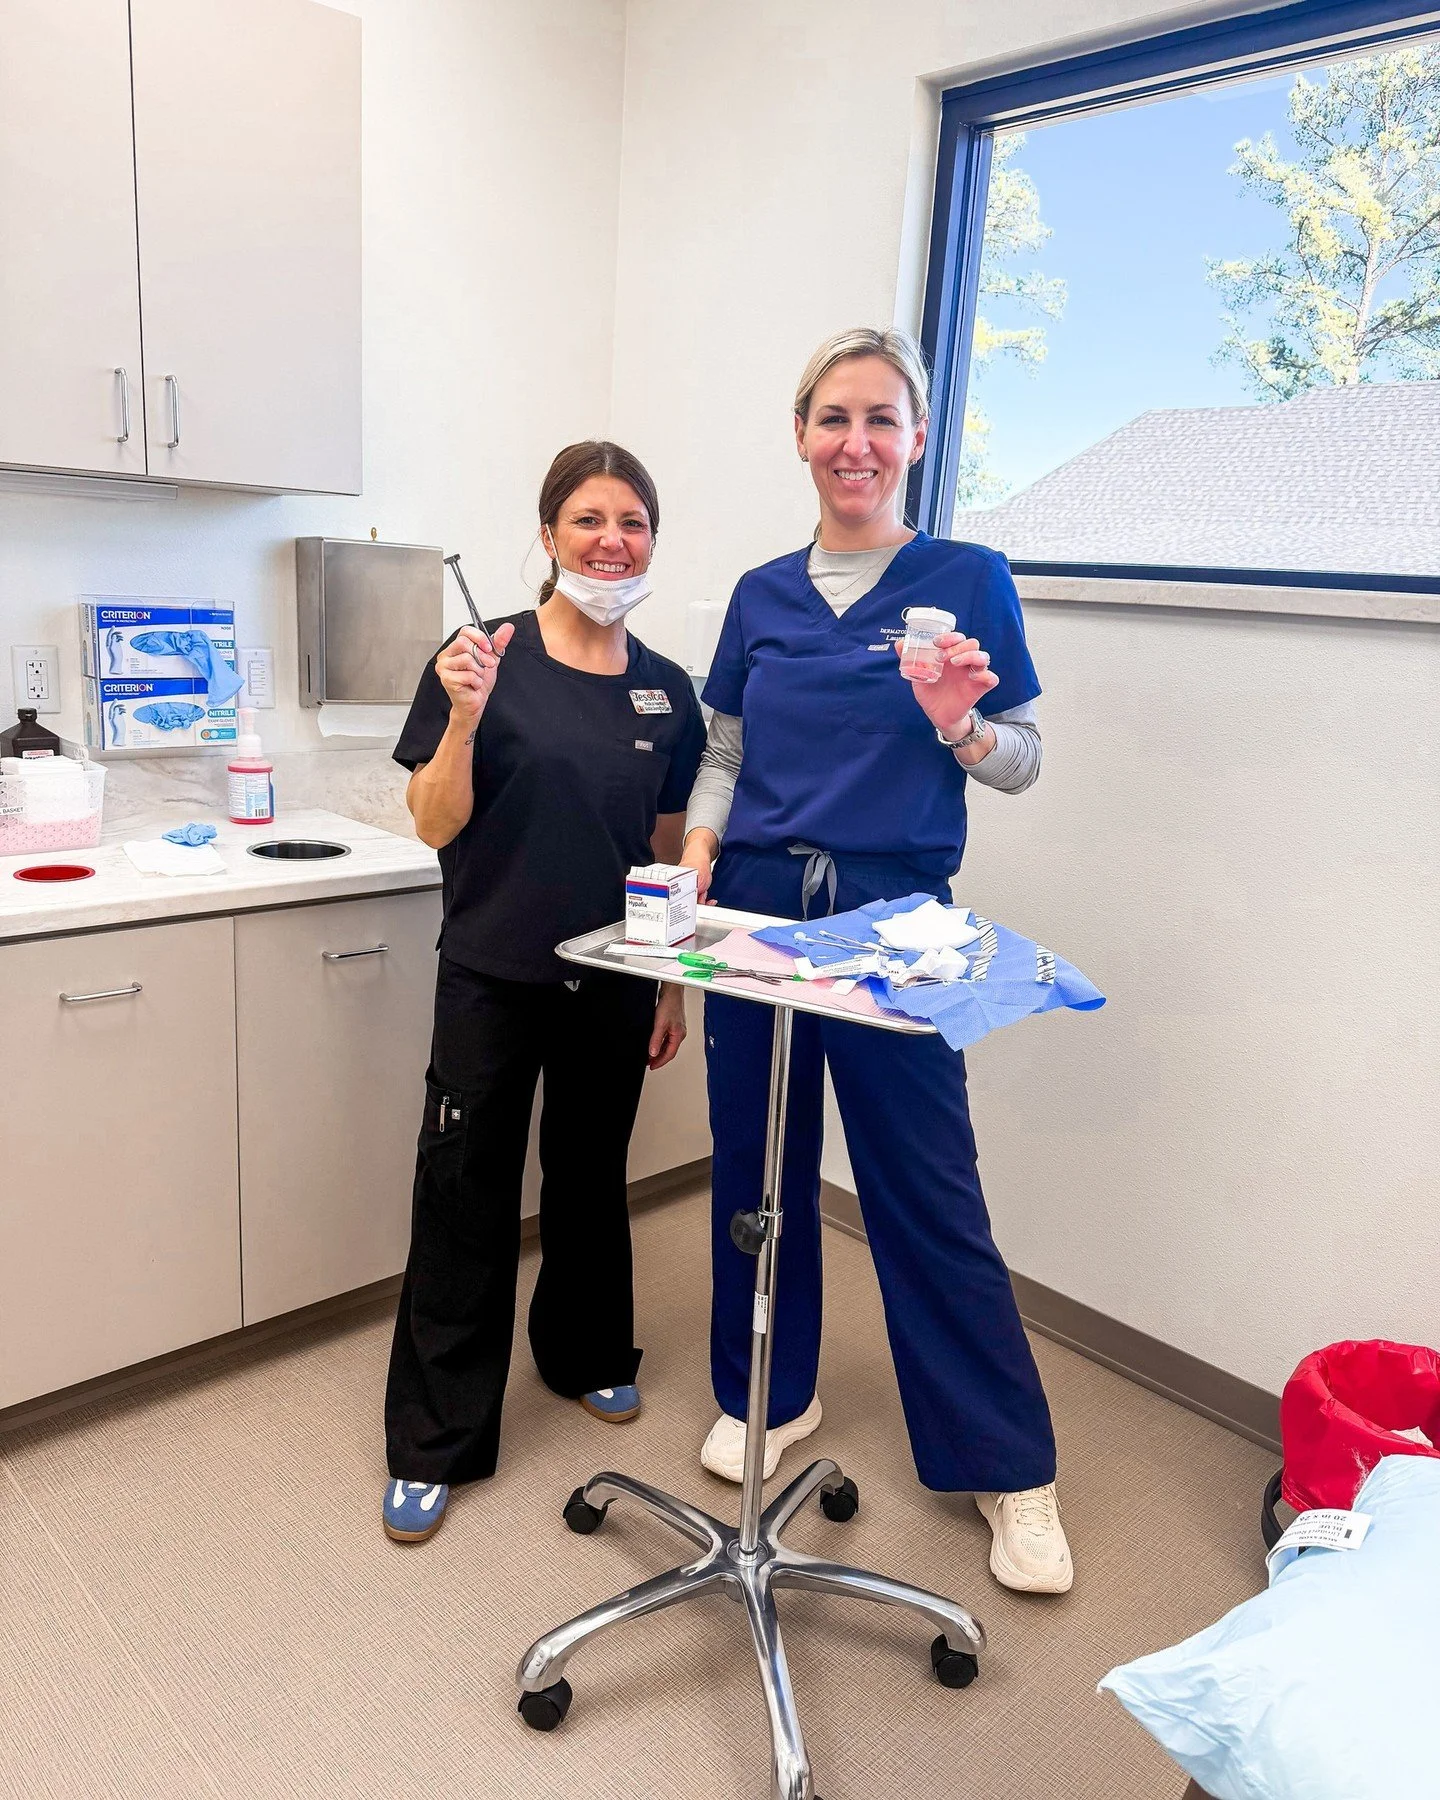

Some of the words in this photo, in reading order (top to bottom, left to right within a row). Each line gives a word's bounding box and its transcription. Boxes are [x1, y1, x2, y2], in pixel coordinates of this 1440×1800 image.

[101, 610, 151, 620] CRITERION
[104, 683, 153, 692] CRITERION
[633, 691, 664, 702] Jessica
[2, 806, 24, 814] BASKET
[628, 900, 648, 908] Hypafix
